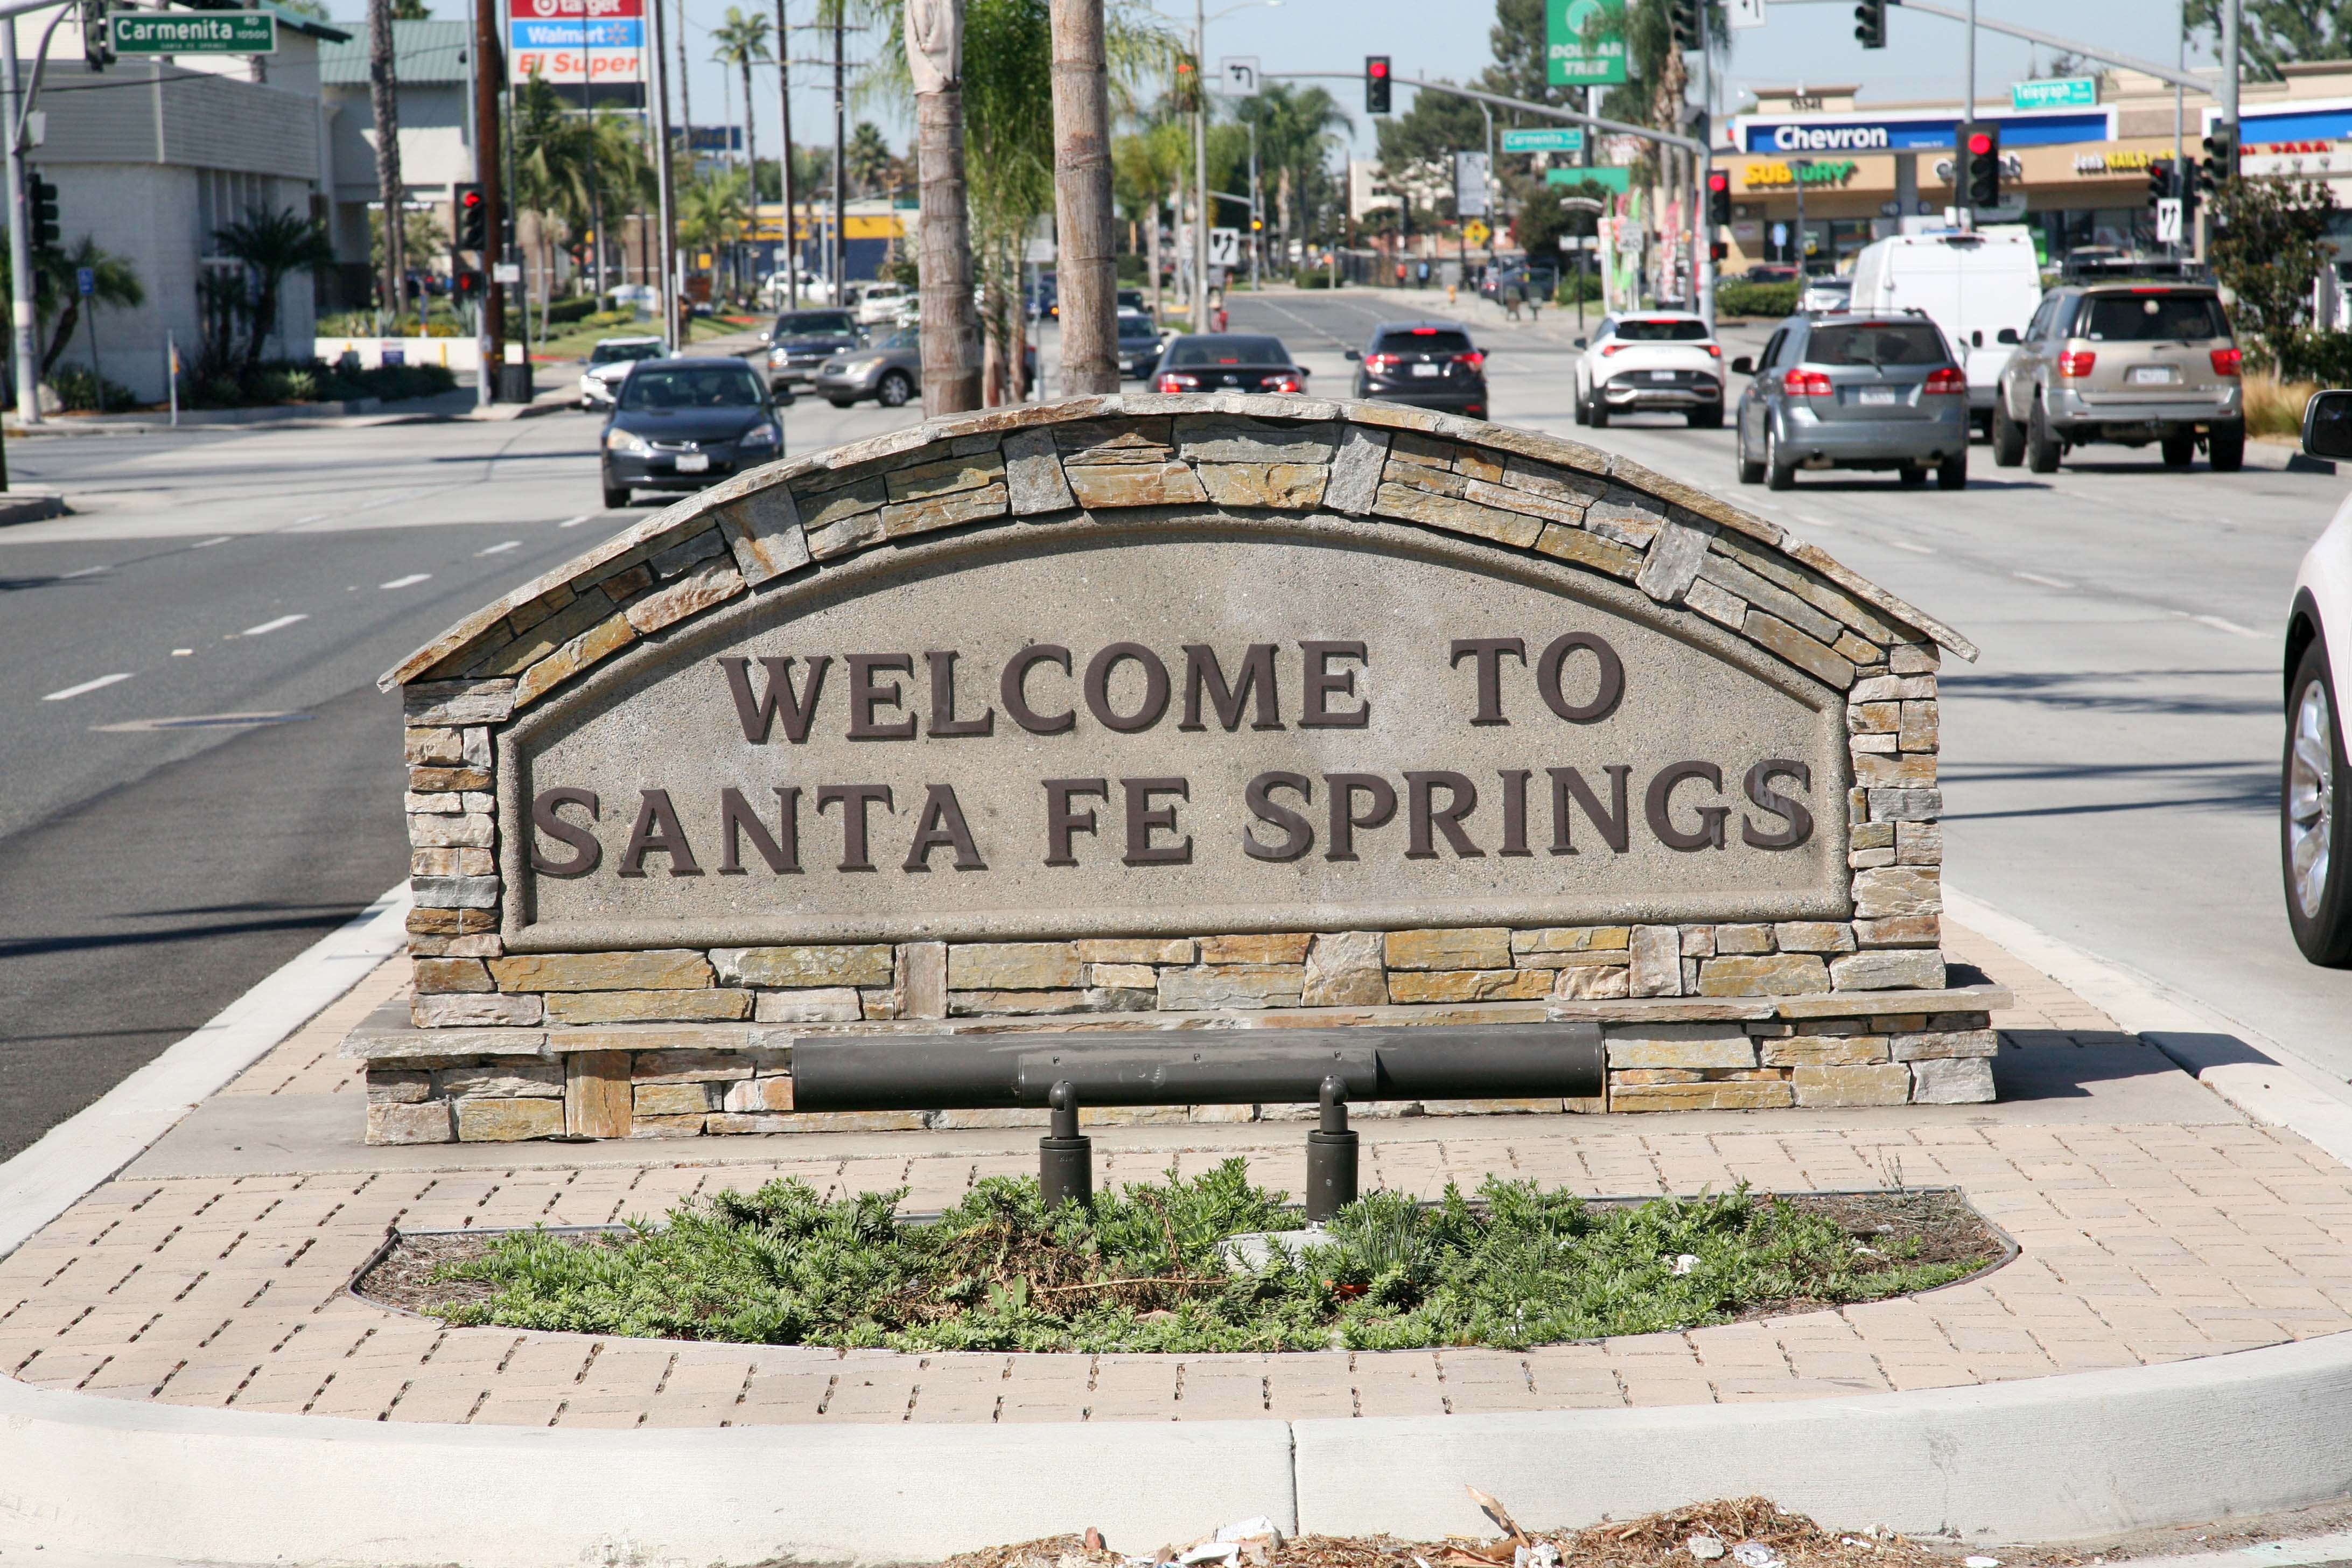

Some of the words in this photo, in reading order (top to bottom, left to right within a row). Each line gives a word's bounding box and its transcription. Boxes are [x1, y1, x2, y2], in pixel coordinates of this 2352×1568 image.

[117, 19, 232, 40] Carmenita
[528, 26, 605, 43] Walmart
[1550, 41, 1622, 59] DOLAR
[519, 53, 545, 73] El
[553, 53, 639, 78] Super
[1775, 125, 1887, 150] Chevron
[717, 640, 1370, 744] WELCOME
[1449, 632, 1625, 726] TO
[531, 783, 988, 878] SANTA
[1041, 776, 1193, 867] FE
[1243, 759, 1815, 863] SPRINGS
